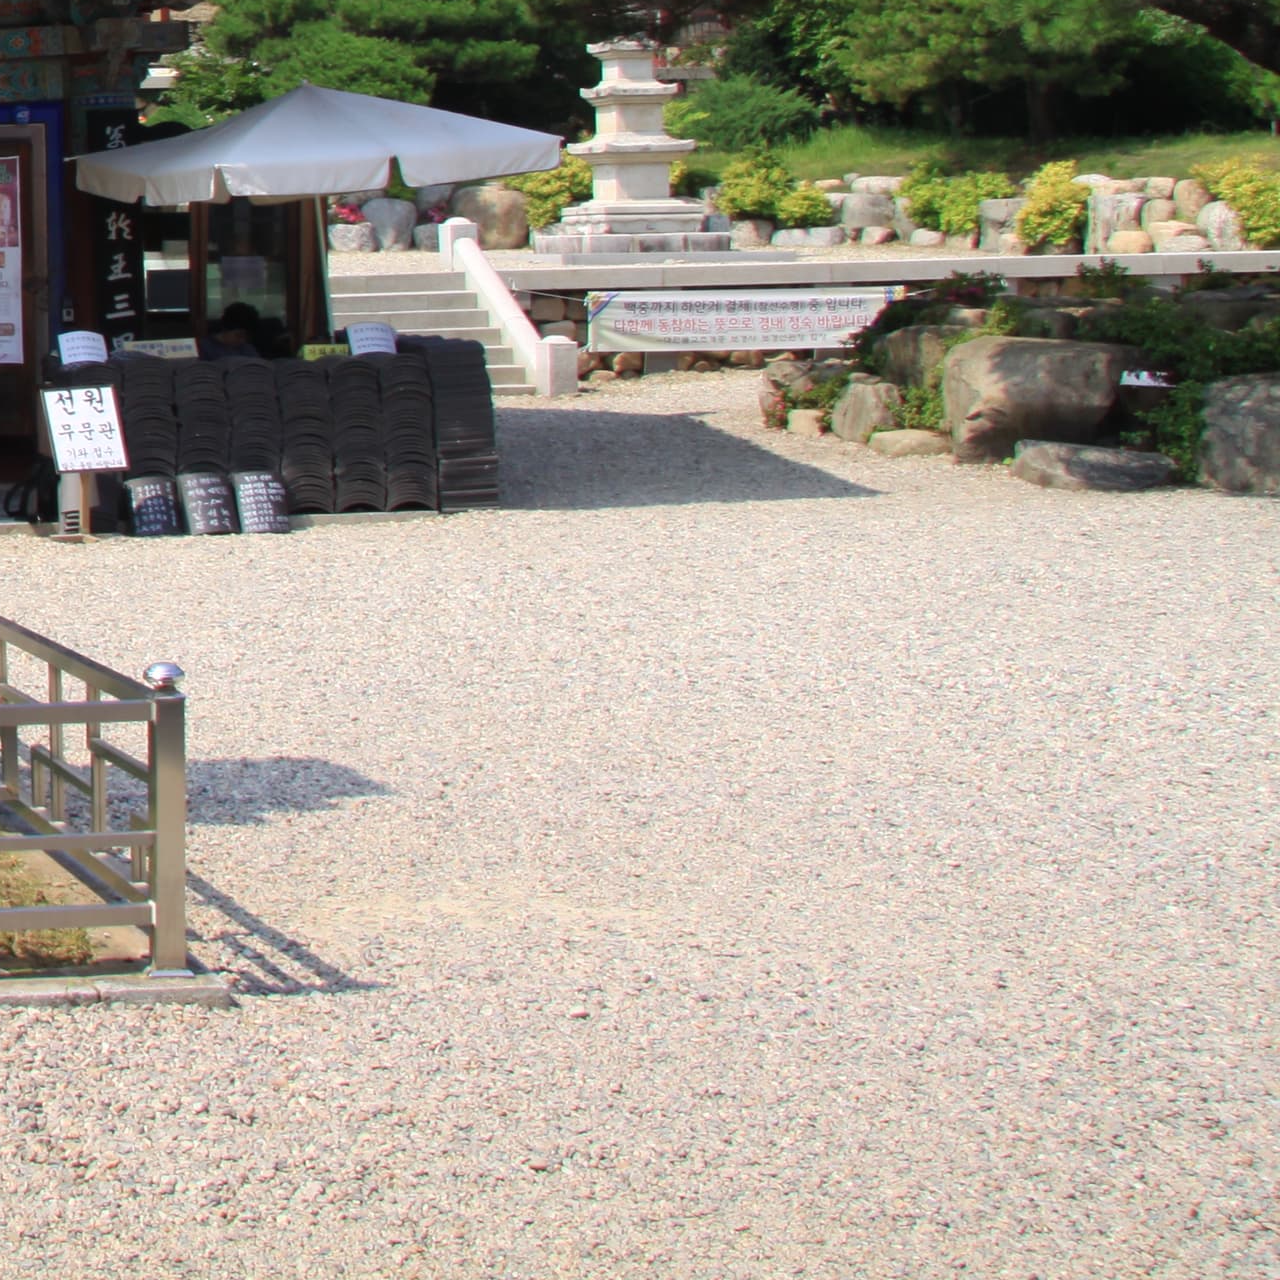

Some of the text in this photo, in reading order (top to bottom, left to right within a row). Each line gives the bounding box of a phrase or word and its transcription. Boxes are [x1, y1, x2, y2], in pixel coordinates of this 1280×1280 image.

[614, 319, 653, 334] 다함께
[658, 318, 709, 333] 동참하는
[759, 315, 784, 331] 경내
[789, 315, 813, 330] 정숙
[56, 387, 104, 415] 선원
[58, 422, 115, 441] 무문관
[66, 446, 114, 459] 기와 접수
